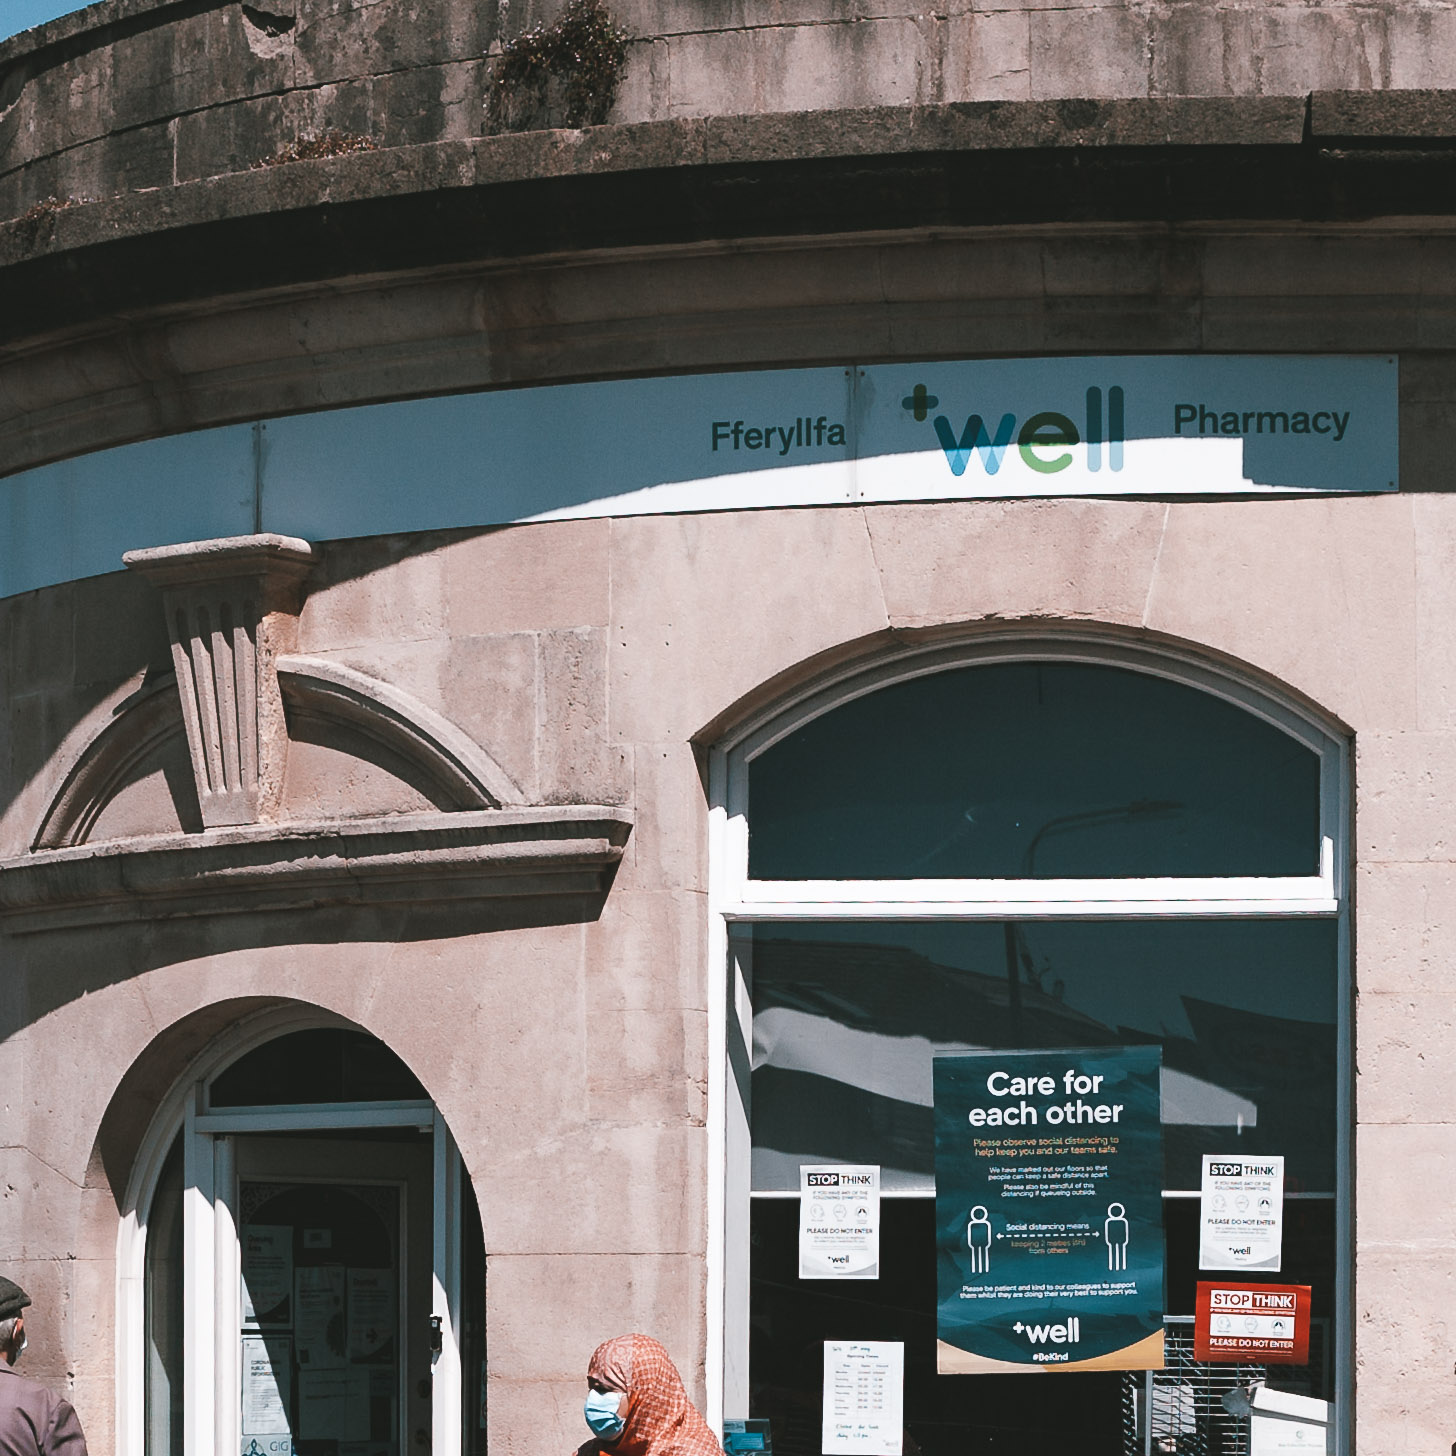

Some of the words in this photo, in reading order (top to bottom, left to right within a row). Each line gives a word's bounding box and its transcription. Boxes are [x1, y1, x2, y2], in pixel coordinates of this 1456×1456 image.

[711, 417, 846, 455] Fferyllfa
[933, 385, 1124, 476] well
[1174, 404, 1351, 440] Pharmacy
[987, 1071, 1055, 1096] Care
[1063, 1070, 1103, 1095] for
[969, 1101, 1037, 1126] each
[1046, 1100, 1123, 1124] other
[974, 1138, 1001, 1146] Please
[1003, 1138, 1037, 1146] observe
[1039, 1137, 1063, 1145] social
[1065, 1136, 1108, 1146] distancing
[975, 1148, 994, 1157] help
[996, 1148, 1017, 1157] keep
[1019, 1149, 1034, 1157] you
[1036, 1147, 1053, 1155] and
[1071, 1146, 1096, 1154] teams
[1098, 1145, 1118, 1154] safe.
[1211, 1165, 1241, 1175] STOP
[1244, 1166, 1274, 1176] THINK
[809, 1175, 838, 1184] STOP
[841, 1176, 871, 1184] THINK
[1006, 1223, 1027, 1231] Social
[1029, 1223, 1065, 1231] distancing
[832, 1255, 849, 1263] well
[995, 1284, 1016, 1292] patient
[1067, 1283, 1101, 1291] colleagues
[1111, 1282, 1136, 1290] support
[1214, 1294, 1249, 1305] STOP
[1254, 1295, 1292, 1308] THINK
[1026, 1317, 1080, 1344] well
[1239, 1339, 1251, 1347] DO
[1253, 1340, 1268, 1348] NOT
[1032, 1352, 1069, 1362] #BeKind
[270, 1441, 288, 1452] GIG
